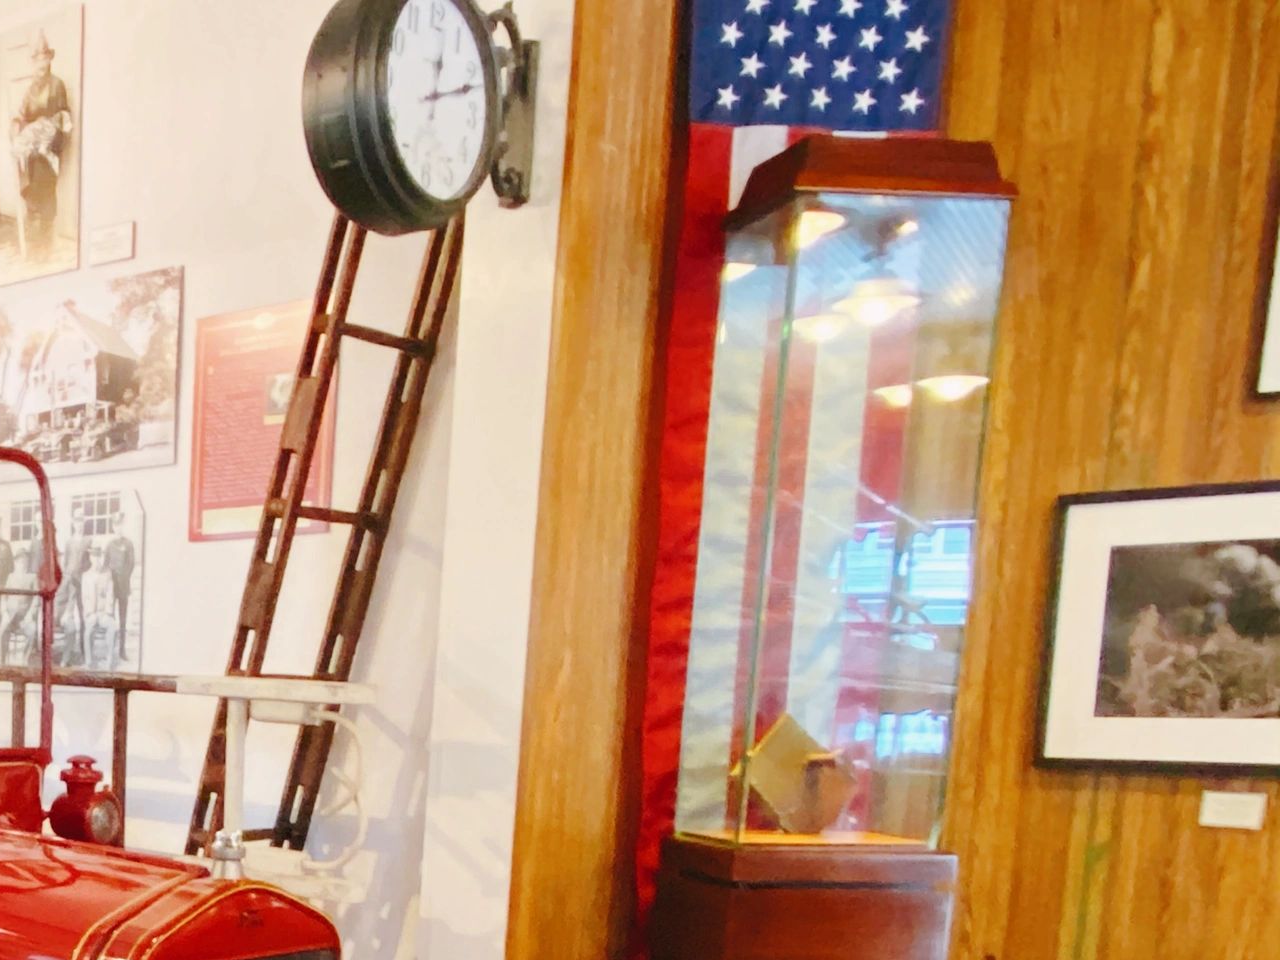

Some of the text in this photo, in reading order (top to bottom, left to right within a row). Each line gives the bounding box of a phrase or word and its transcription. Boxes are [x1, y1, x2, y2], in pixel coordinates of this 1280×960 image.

[407, 2, 420, 34] 11
[430, 1, 446, 32] 12
[467, 100, 478, 130] 3
[460, 135, 469, 165] 4
[420, 151, 432, 190] 6
[441, 155, 455, 187] 5
